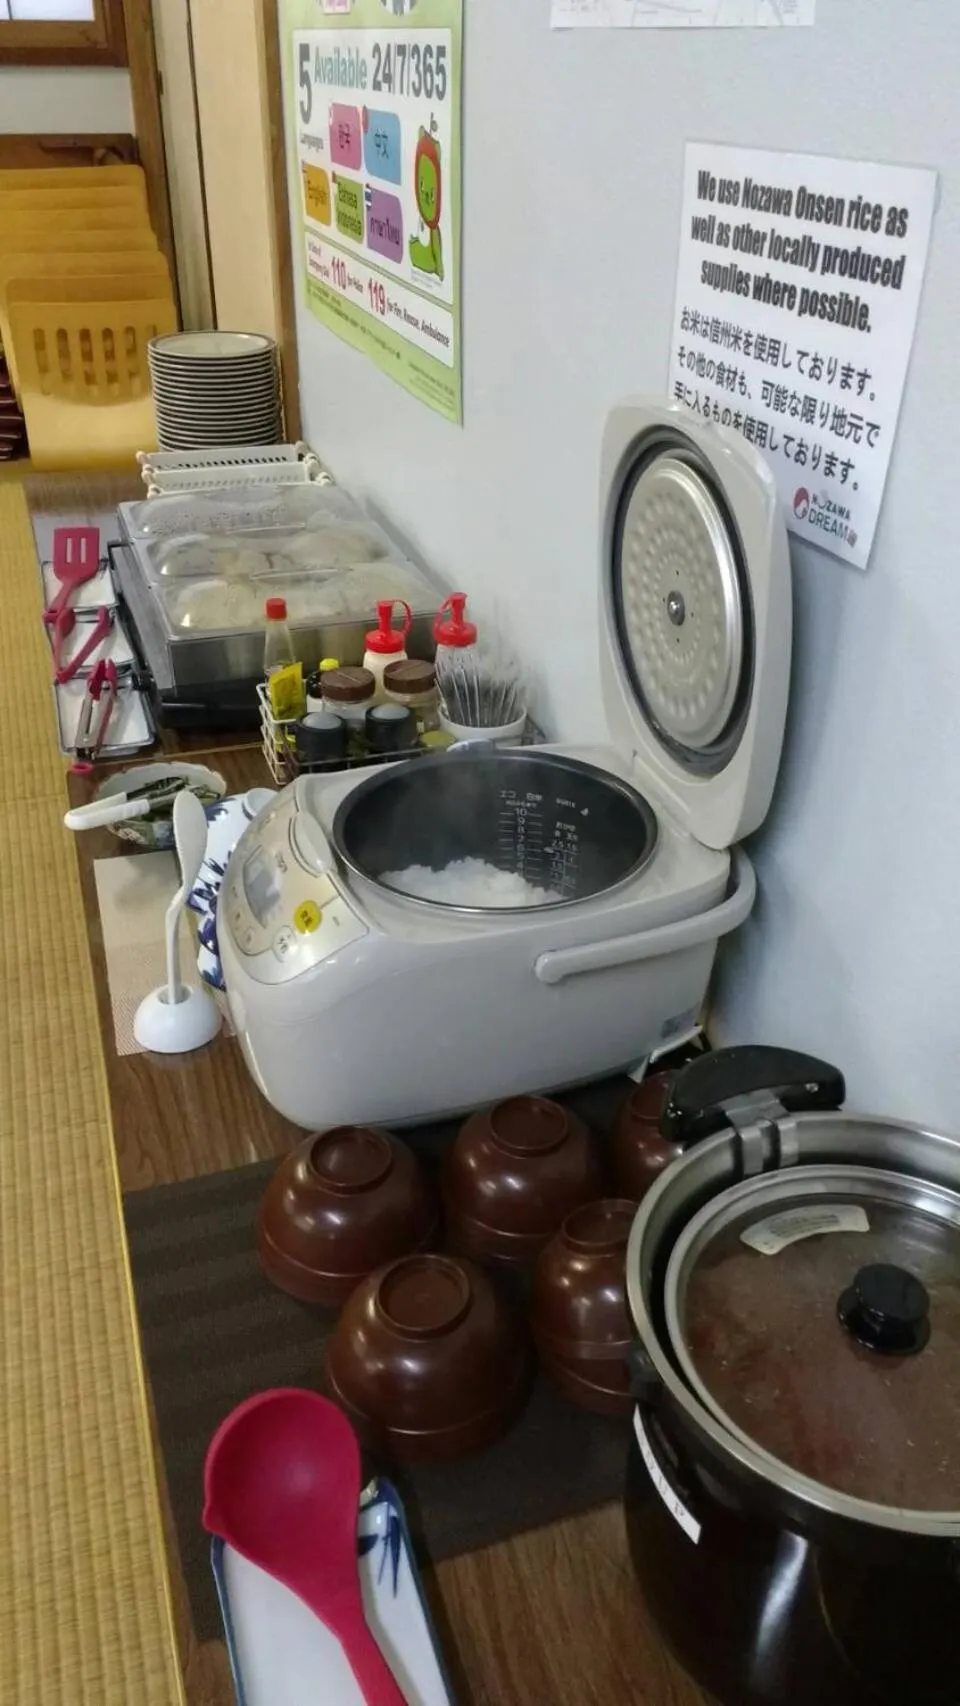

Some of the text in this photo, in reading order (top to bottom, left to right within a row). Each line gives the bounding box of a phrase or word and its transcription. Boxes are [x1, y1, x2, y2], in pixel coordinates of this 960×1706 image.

[299, 42, 447, 124] 5 Available 24/7/365
[697, 169, 910, 239] We use Nozawa Onsen rice as
[691, 214, 907, 291] well as other locally produced
[331, 256, 346, 290] 110
[368, 277, 386, 316] 119
[421, 320, 450, 348] Ambulance
[700, 259, 872, 334] supplies where possible.
[680, 306, 876, 401] お米は信州米を使用しております。
[677, 346, 882, 448] その他の食材も、可能な限り地元で
[515, 807, 528, 817] 10
